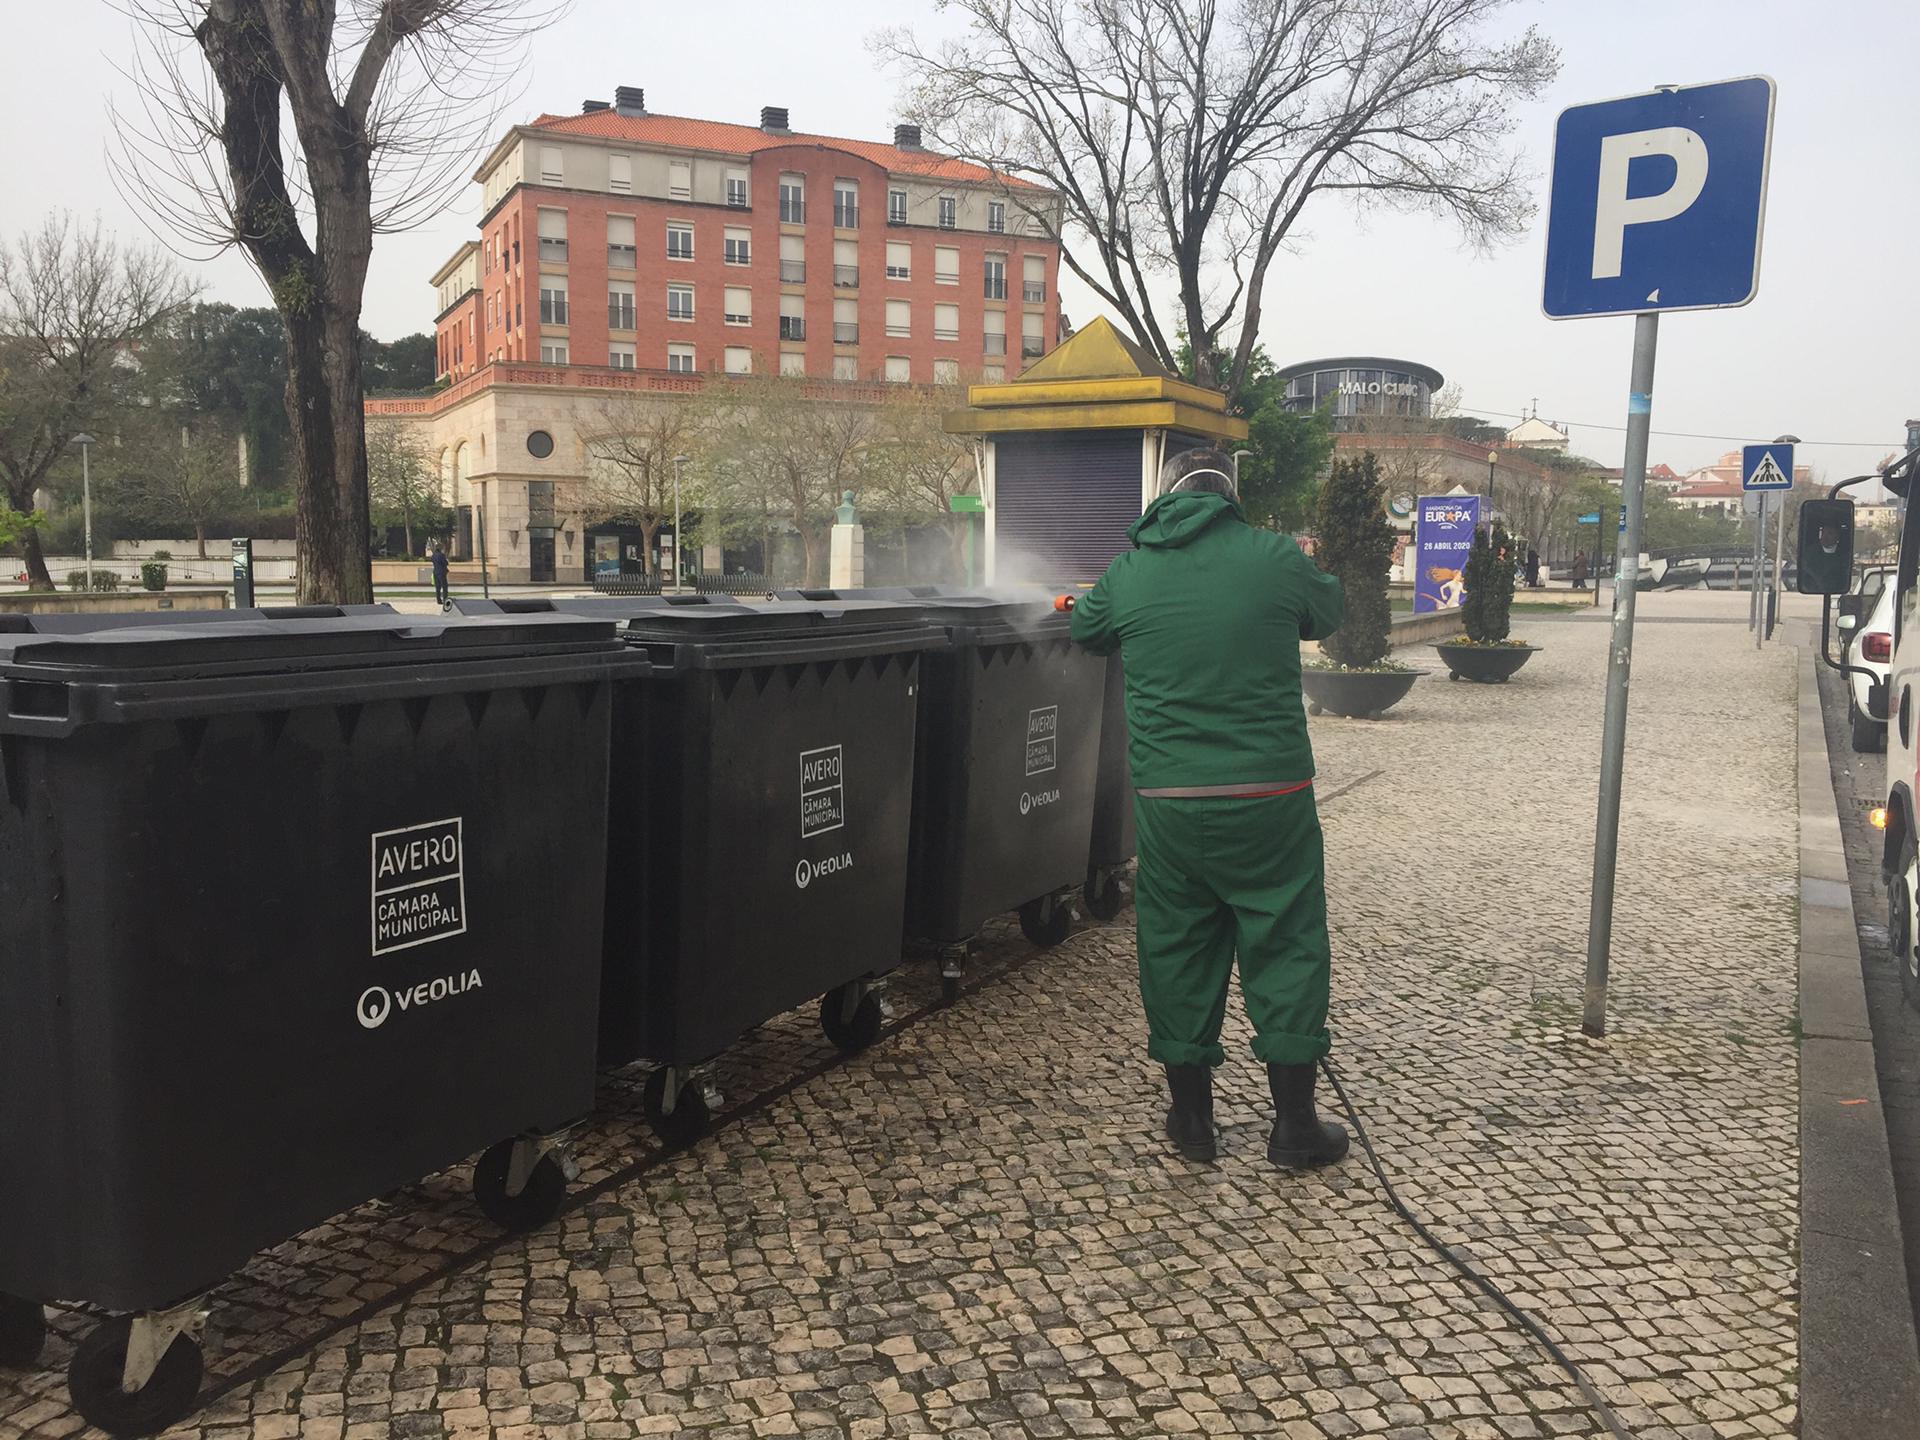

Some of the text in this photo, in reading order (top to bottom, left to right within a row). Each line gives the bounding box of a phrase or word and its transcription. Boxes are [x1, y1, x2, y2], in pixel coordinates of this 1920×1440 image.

[1591, 126, 1709, 279] P
[1338, 382, 1381, 395] MALO
[1434, 542, 1453, 550] ABRIL
[1453, 542, 1471, 550] 2020
[1031, 789, 1060, 808] VEOLIA
[804, 807, 841, 828] MUNICIPAL
[812, 851, 854, 878] VEOLIA
[379, 906, 459, 941] MUNICIPAL
[394, 968, 483, 1011] VEOLIA
